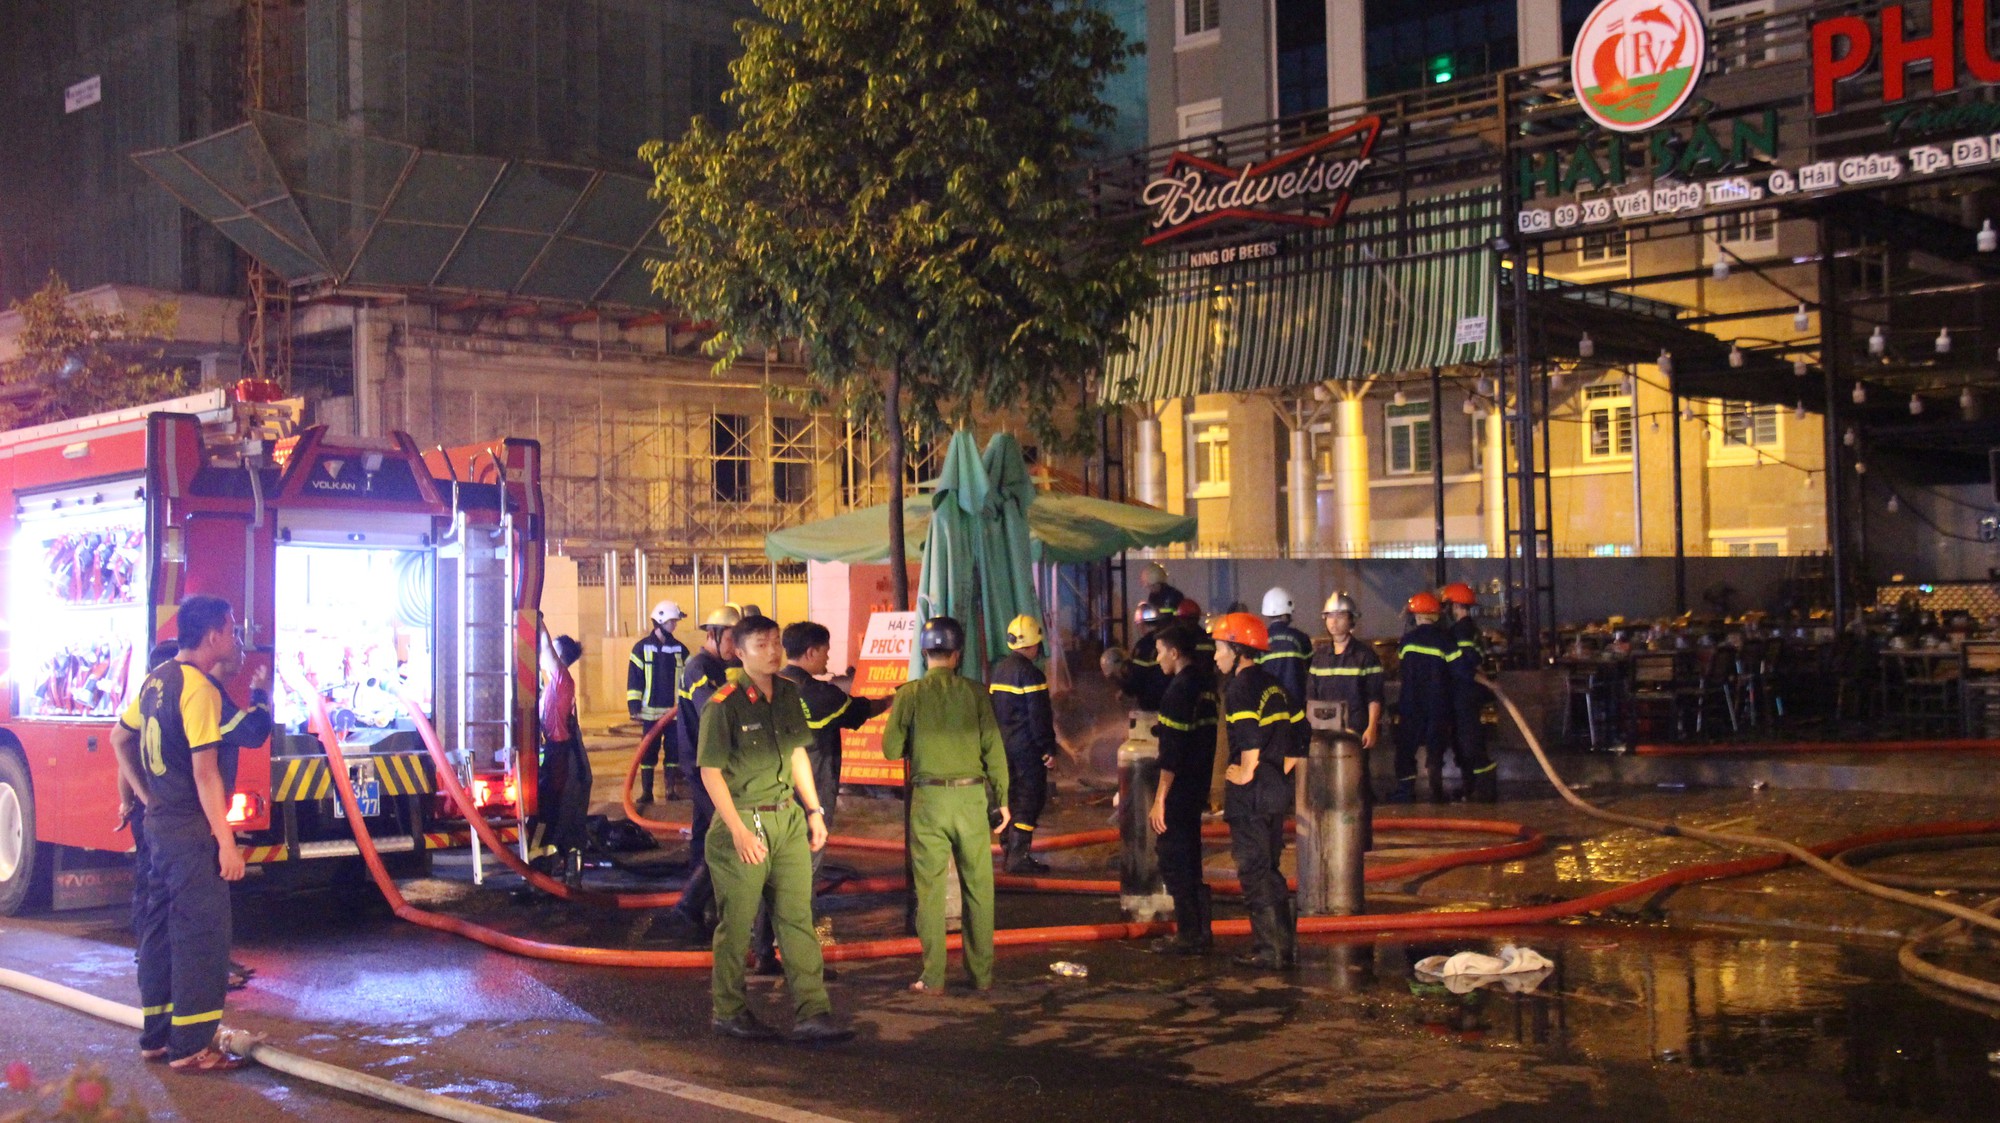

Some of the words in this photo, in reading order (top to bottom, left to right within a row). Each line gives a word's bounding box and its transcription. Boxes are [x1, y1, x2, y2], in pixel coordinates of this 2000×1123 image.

[1142, 155, 1371, 228] Budweiser
[1557, 207, 1575, 224] 39
[1586, 203, 1608, 219] Xô
[1616, 195, 1648, 215] Viết
[1656, 189, 1698, 211] Nghệ
[1190, 250, 1218, 268] KING
[1221, 246, 1236, 262] OF
[1239, 241, 1278, 260] BEERS
[312, 480, 356, 491] VOLKAN
[869, 635, 905, 654] PHÚC
